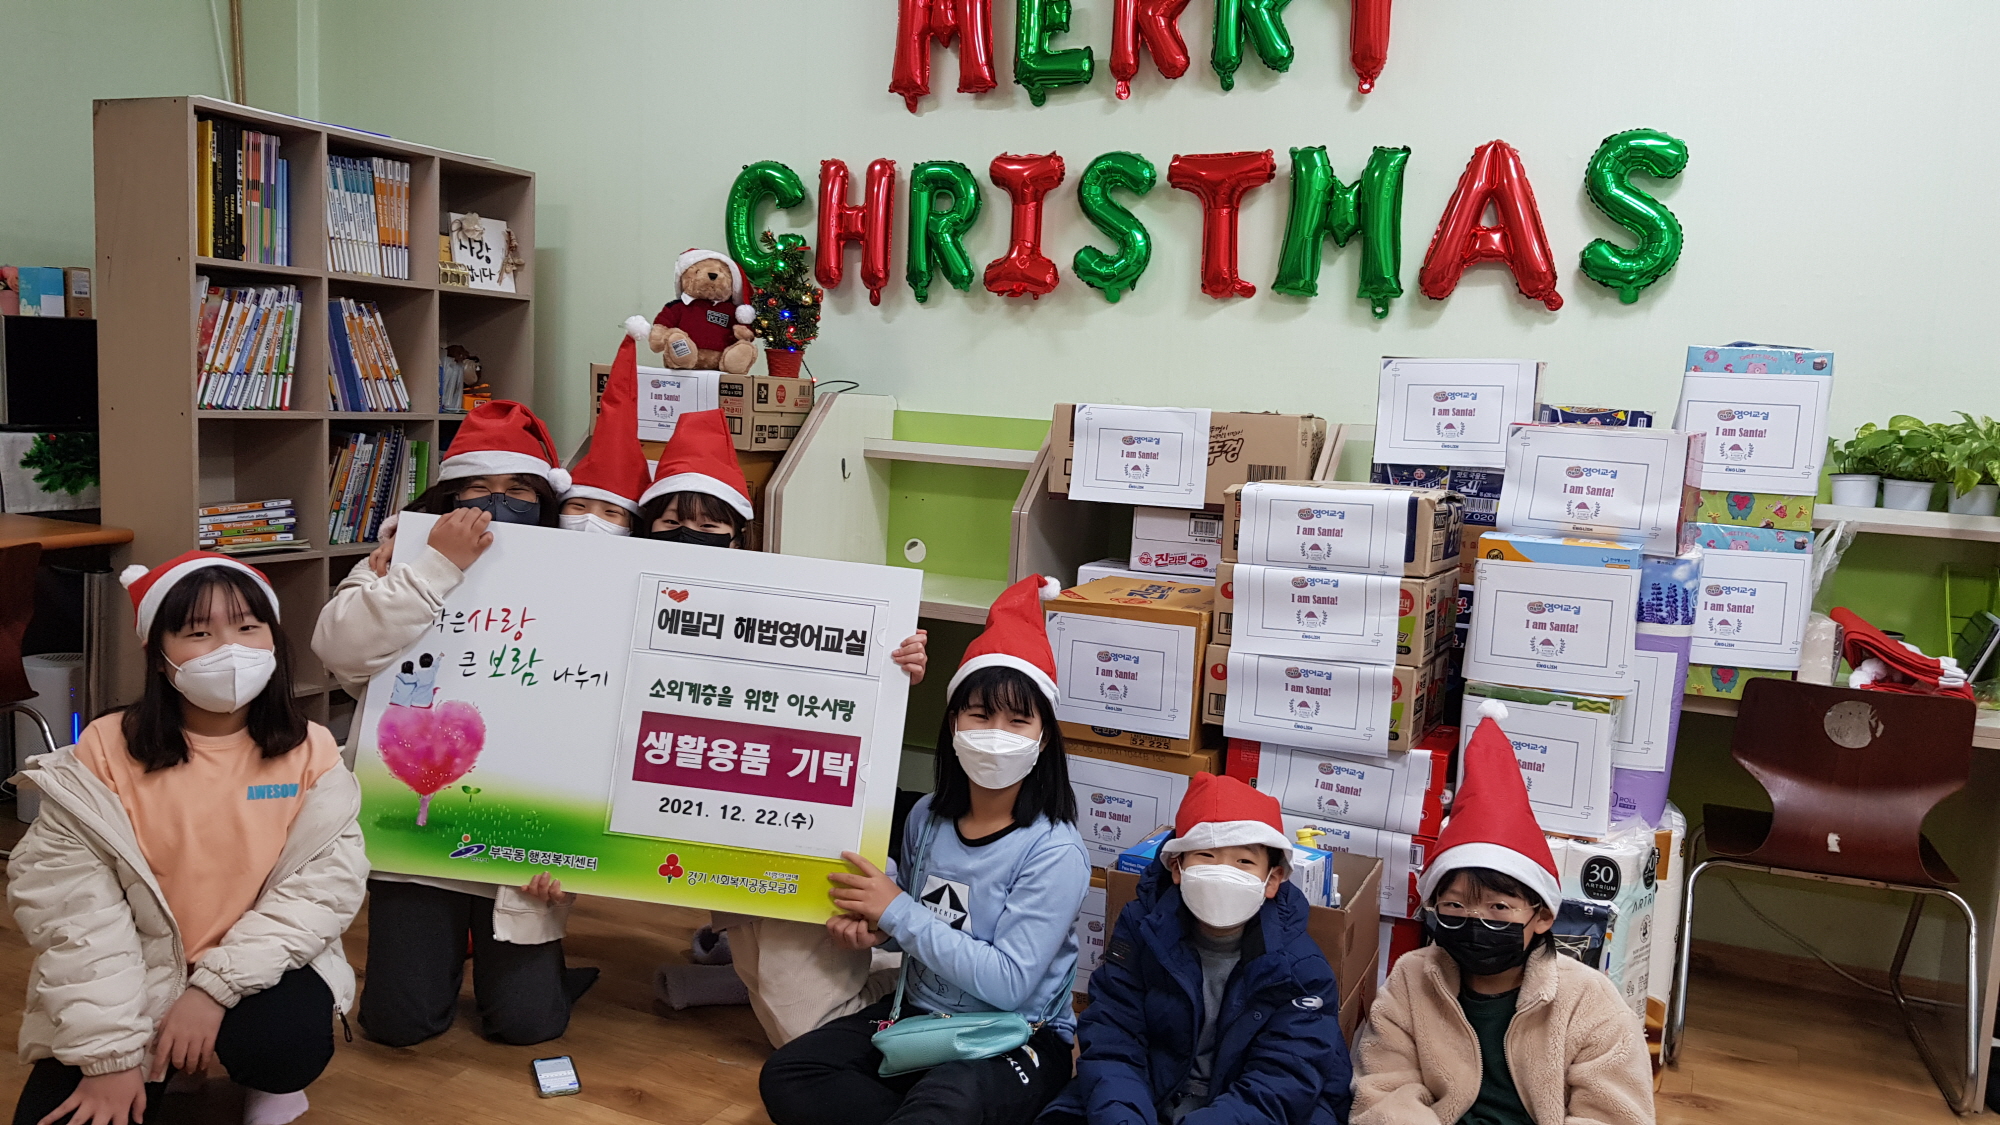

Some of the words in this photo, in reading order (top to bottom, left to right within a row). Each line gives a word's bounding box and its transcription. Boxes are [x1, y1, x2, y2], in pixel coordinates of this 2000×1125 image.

[725, 127, 1689, 314] CHRISTMAS
[459, 239, 492, 265] 사랑
[663, 393, 681, 402] Santa!
[1438, 408, 1450, 416] am
[1451, 407, 1476, 417] Santa!
[1721, 428, 1736, 437] am
[1738, 427, 1767, 438] Santa!
[1127, 451, 1137, 459] am
[1138, 450, 1159, 460] Santa!
[1569, 485, 1584, 495] am
[1585, 485, 1615, 498] Santa!
[1302, 527, 1315, 536] am
[1317, 526, 1344, 538] Santa!
[1154, 552, 1187, 567] 진라면
[1297, 595, 1310, 604] am
[1312, 594, 1338, 606] Santa!
[1710, 603, 1724, 612] am
[1726, 602, 1755, 614] Santa!
[657, 608, 725, 639] 에밀리
[733, 616, 867, 656] 해법영어교실
[1532, 621, 1547, 630] am
[1549, 621, 1579, 634] Santa!
[458, 651, 477, 677] 큰
[488, 643, 544, 686] 보람
[553, 663, 608, 690] 나누기
[1101, 668, 1113, 678] am
[1114, 669, 1138, 681] Santa!
[1290, 684, 1303, 693] am
[1305, 685, 1332, 697] Santa!
[649, 678, 734, 708] 소외계층을
[744, 688, 779, 713] 위한
[787, 693, 856, 722] 이웃사랑
[1131, 738, 1145, 746] 52
[1149, 741, 1170, 750] 225
[642, 731, 771, 776] 생활용품
[787, 748, 854, 787] 기탁
[1517, 758, 1545, 773] Santa!
[1321, 781, 1333, 791] am
[1335, 782, 1362, 797] Santa!
[1619, 796, 1636, 804] ROLL
[658, 797, 709, 818] 2021.
[720, 804, 746, 822] 12.
[1094, 810, 1107, 819] am
[1108, 810, 1131, 823] Santa!
[489, 846, 526, 863] 부곡동
[528, 850, 598, 871] 행정복지센터
[1588, 863, 1614, 883] 30
[687, 871, 708, 886] 경기
[709, 874, 798, 895] 사회복지공동모금회
[1092, 937, 1103, 947] am
